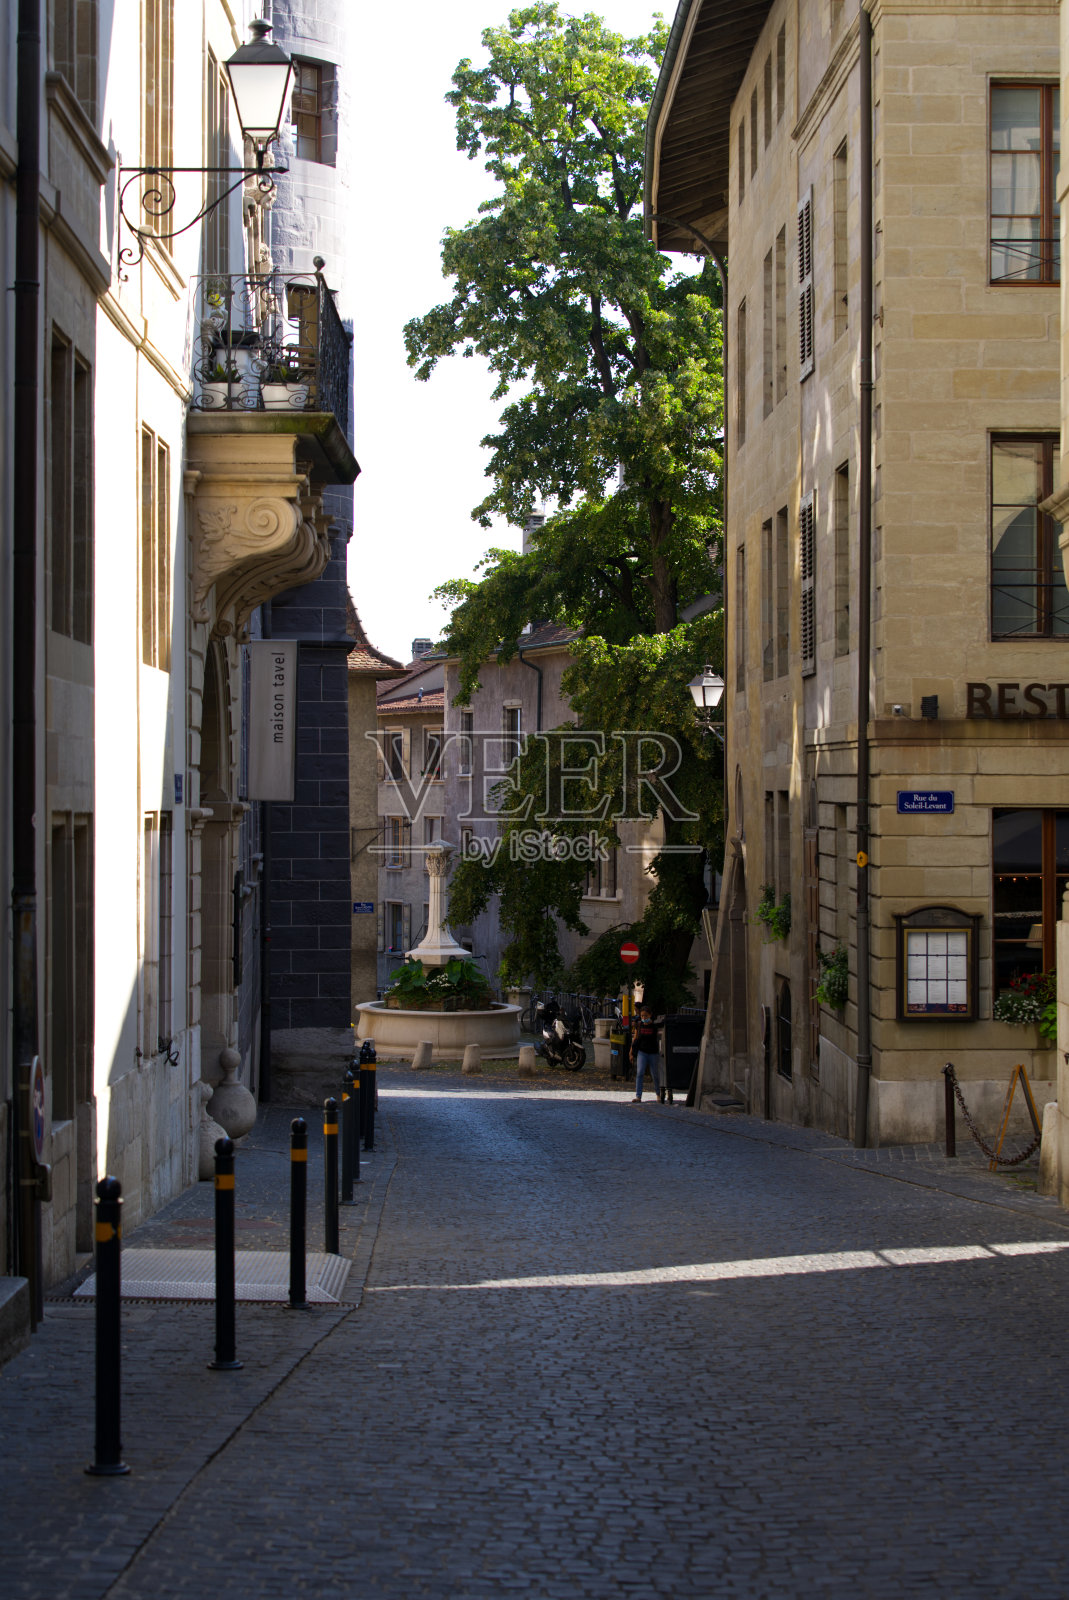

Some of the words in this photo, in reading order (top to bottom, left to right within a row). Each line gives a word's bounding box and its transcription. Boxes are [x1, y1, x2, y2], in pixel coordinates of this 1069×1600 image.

[271, 652, 285, 687] tavel
[270, 694, 284, 743] maison
[965, 682, 1069, 719] REST
